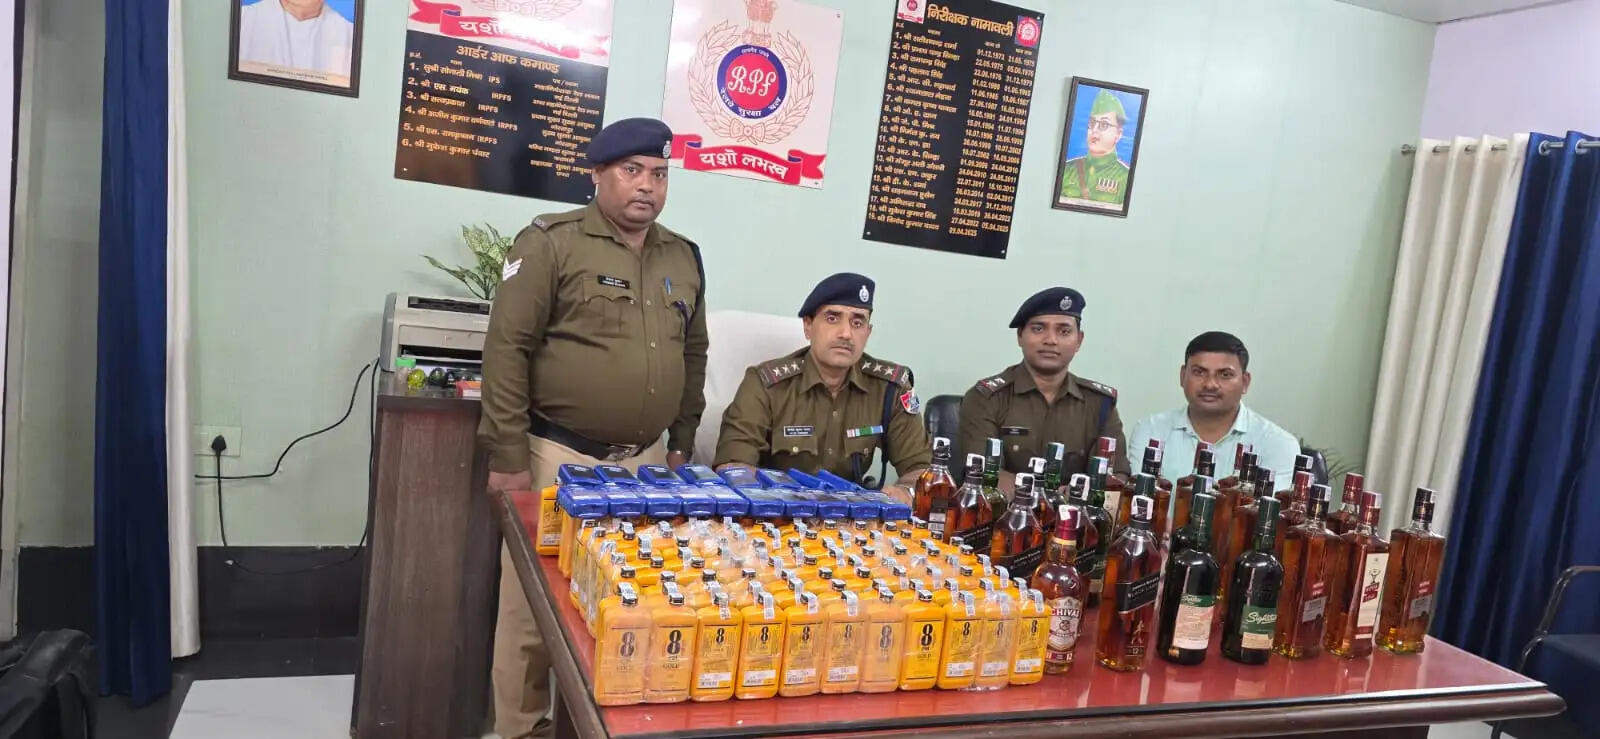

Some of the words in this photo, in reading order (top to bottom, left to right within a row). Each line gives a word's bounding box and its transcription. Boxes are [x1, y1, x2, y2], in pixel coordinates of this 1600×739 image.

[927, 3, 969, 25] निरीक्षक
[970, 16, 1014, 36] नामावली
[456, 46, 488, 59] आर्डर
[490, 52, 518, 64] आफ
[406, 91, 416, 100] 3.
[408, 77, 418, 86] 2.
[492, 92, 511, 101] IRPFS
[405, 106, 415, 114] 4.
[403, 123, 413, 131] 5.
[402, 139, 412, 147] 6.
[761, 626, 768, 641] 8
[802, 626, 810, 641] 8
[845, 624, 852, 638] 8
[963, 622, 970, 636] 8
[1031, 620, 1037, 632] 8
[667, 630, 682, 654] 8
[716, 628, 724, 644] 8
[880, 625, 892, 648] 8
[921, 624, 933, 646] 8
[621, 632, 634, 657] 8
